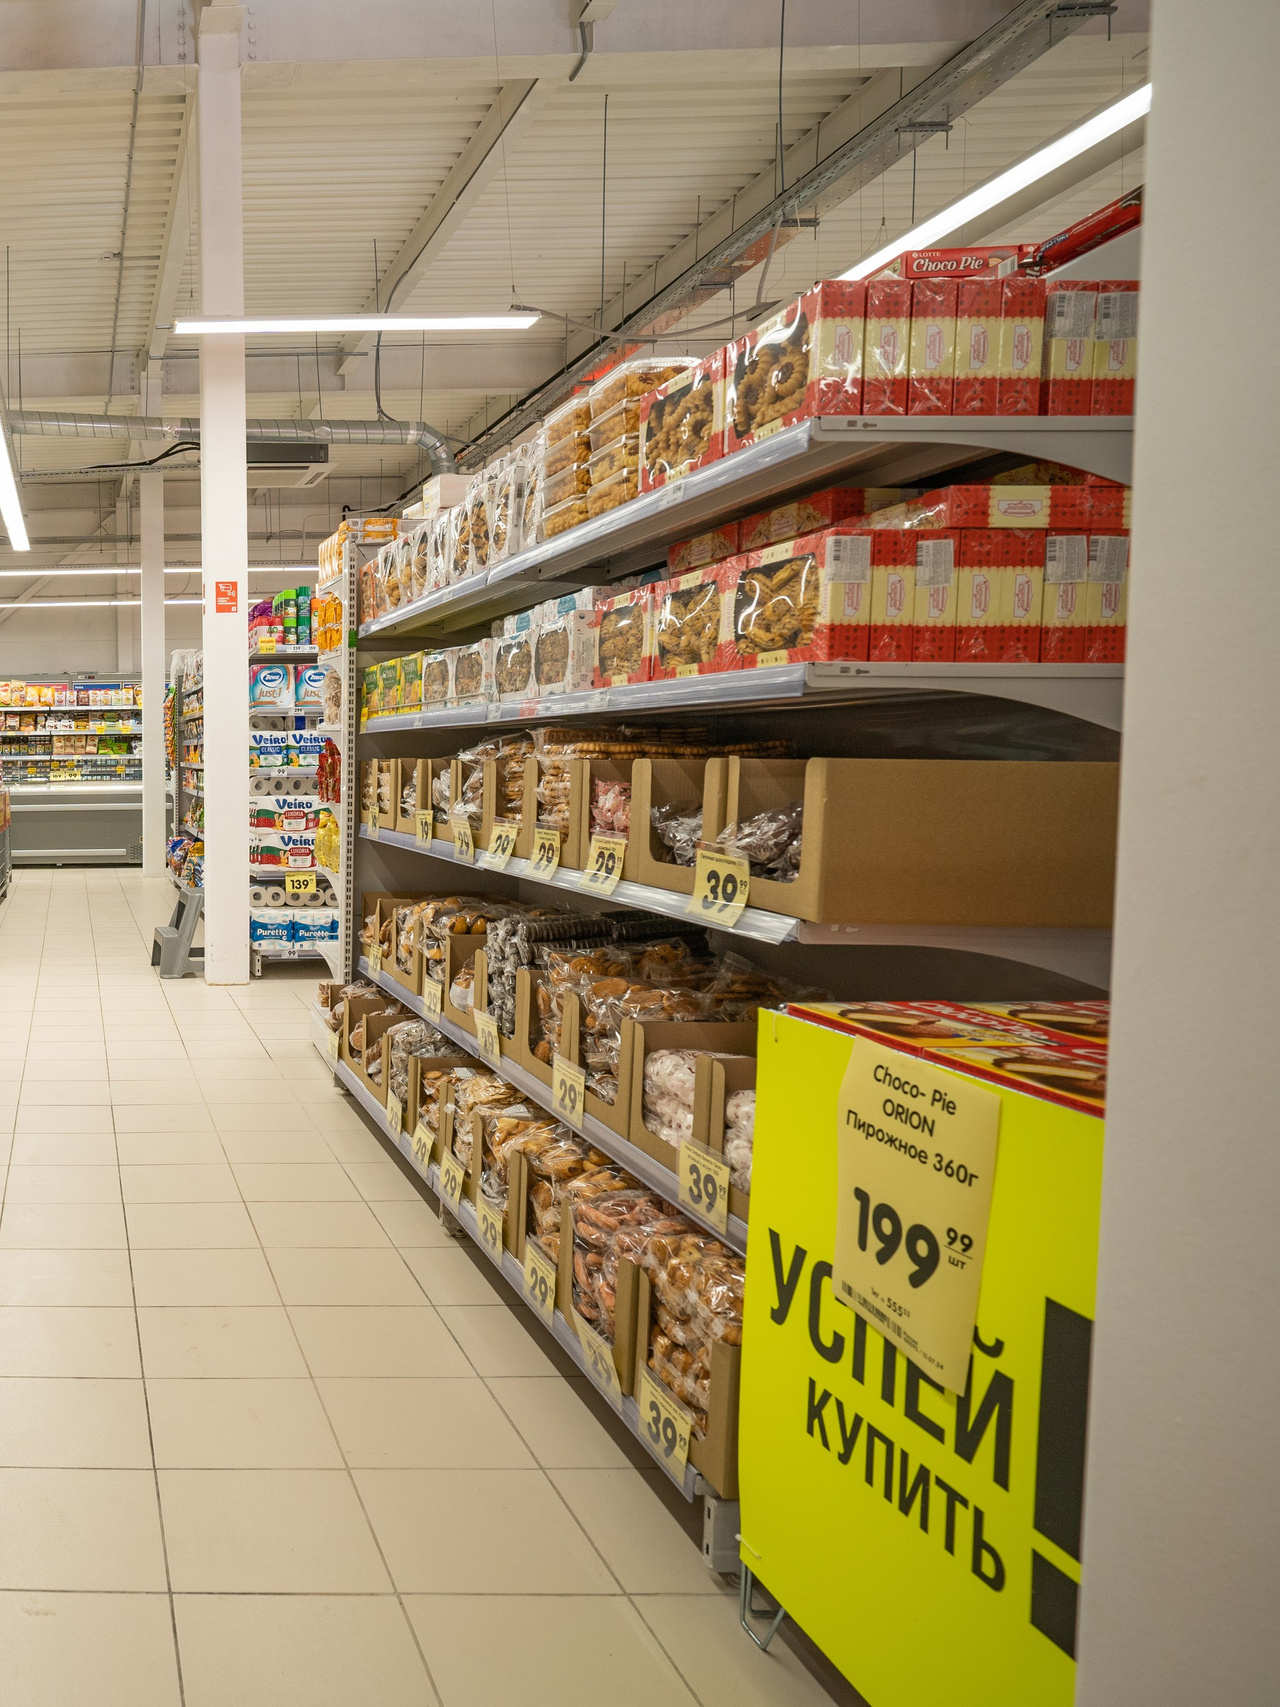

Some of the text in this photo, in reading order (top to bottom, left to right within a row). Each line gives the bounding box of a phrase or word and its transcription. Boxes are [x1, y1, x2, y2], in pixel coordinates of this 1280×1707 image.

[913, 256, 984, 273] Choco Pie
[263, 673, 285, 683] Zewa
[252, 733, 287, 745] Veiro
[300, 745, 322, 753] CLASSIC
[275, 798, 314, 810] Veiro
[283, 810, 306, 818] LUXORIA
[420, 819, 429, 843] 19
[458, 829, 470, 856] 29
[289, 847, 310, 855] LUXORIA
[492, 833, 510, 860] 29
[533, 841, 555, 872] 29
[588, 850, 617, 885] 29
[290, 879, 310, 890] 139
[702, 869, 748, 914] 39 99
[256, 928, 288, 937] Puretto
[298, 929, 329, 938] Puretto
[427, 989, 438, 1015] 29
[481, 1027, 495, 1056] 29
[559, 1078, 578, 1116] 29
[873, 1064, 957, 1116] Choco- Pie
[389, 1106, 400, 1130] 29
[882, 1098, 936, 1137] ORION
[415, 1136, 427, 1162] 29
[846, 1109, 980, 1188] Пирожное 360г
[443, 1166, 457, 1198] 29
[688, 1162, 727, 1214] 39 99
[481, 1212, 499, 1249] 29
[853, 1186, 974, 1290] 199 99
[948, 1254, 968, 1270] шт
[530, 1265, 549, 1304] 29
[885, 1296, 904, 1318] 555
[647, 1399, 688, 1459] 39 99
[806, 1376, 1006, 1593] КУПИТЬ
